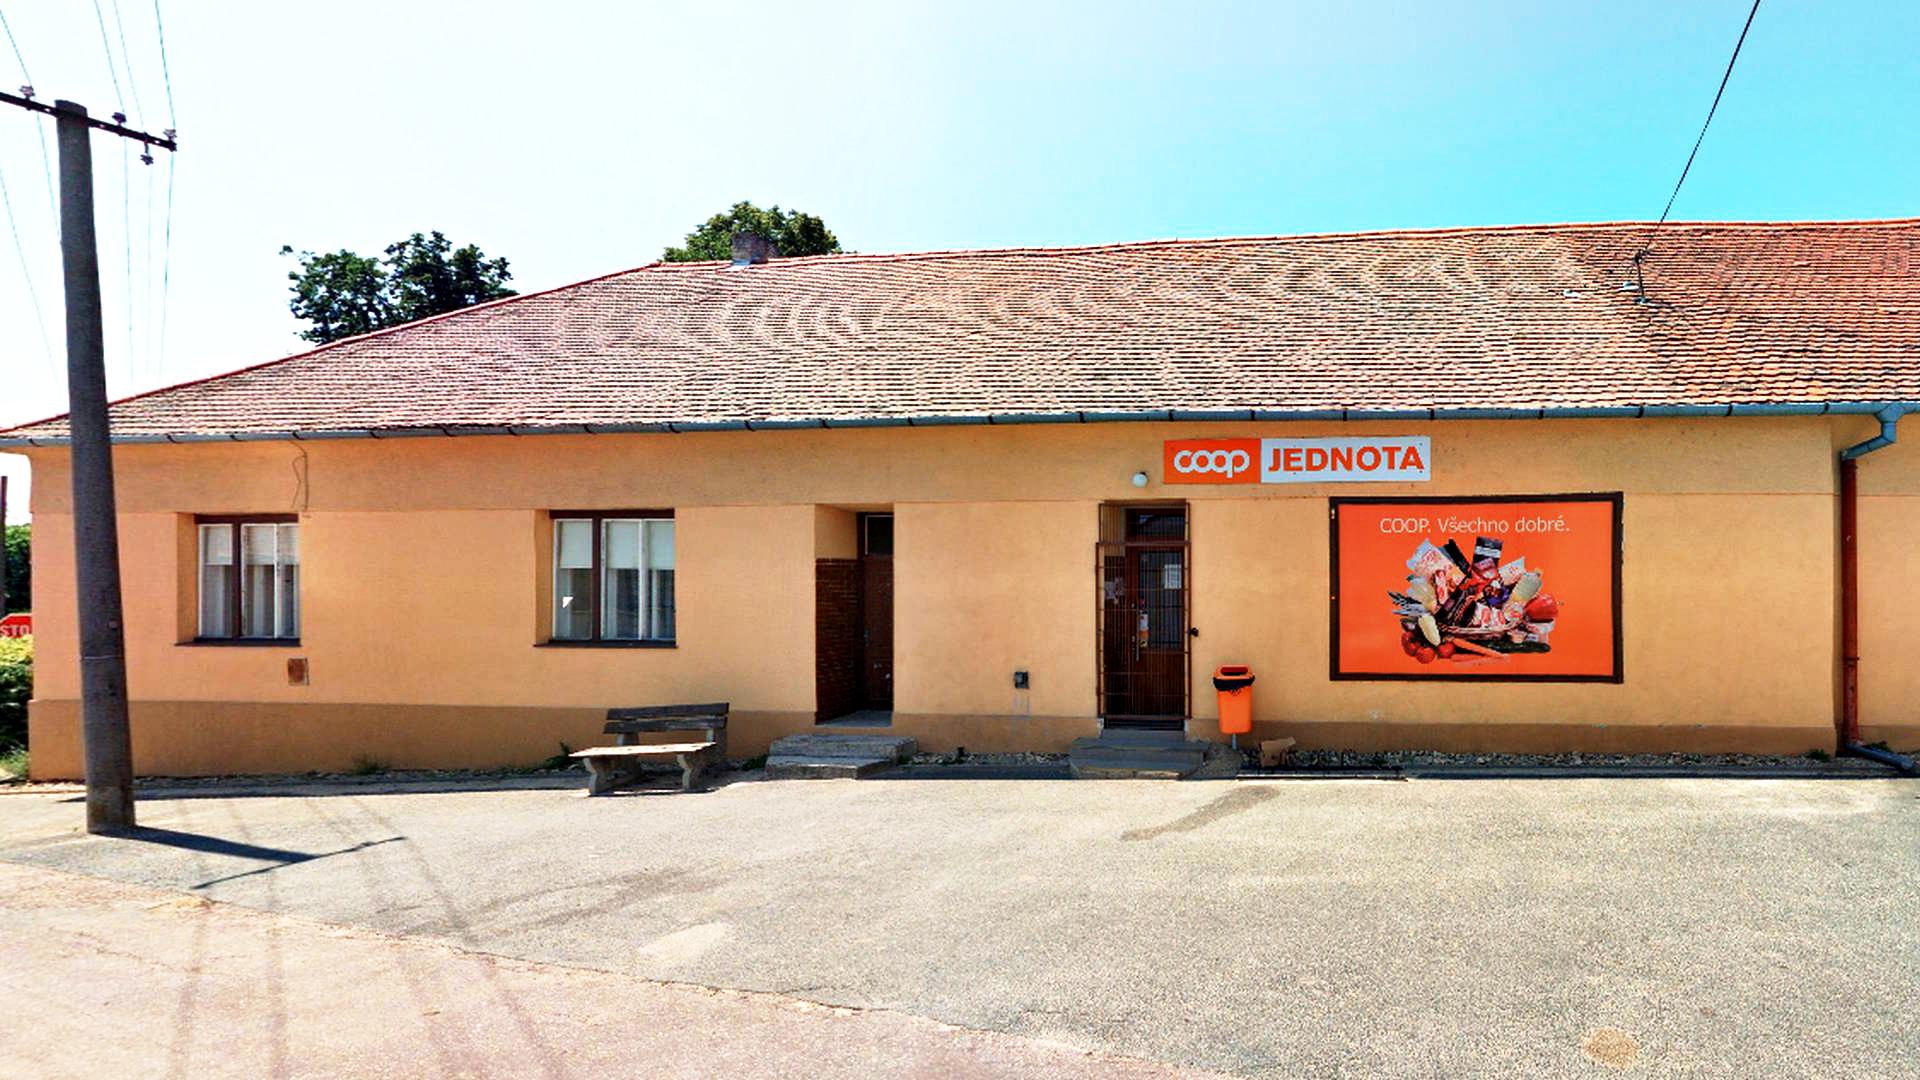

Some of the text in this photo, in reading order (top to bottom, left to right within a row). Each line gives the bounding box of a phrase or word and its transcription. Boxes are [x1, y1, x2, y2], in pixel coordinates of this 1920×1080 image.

[1174, 446, 1425, 478] coop JEDNOTA
[1379, 514, 1570, 534] COOP. Všechno dobré.
[0, 624, 30, 637] STO
